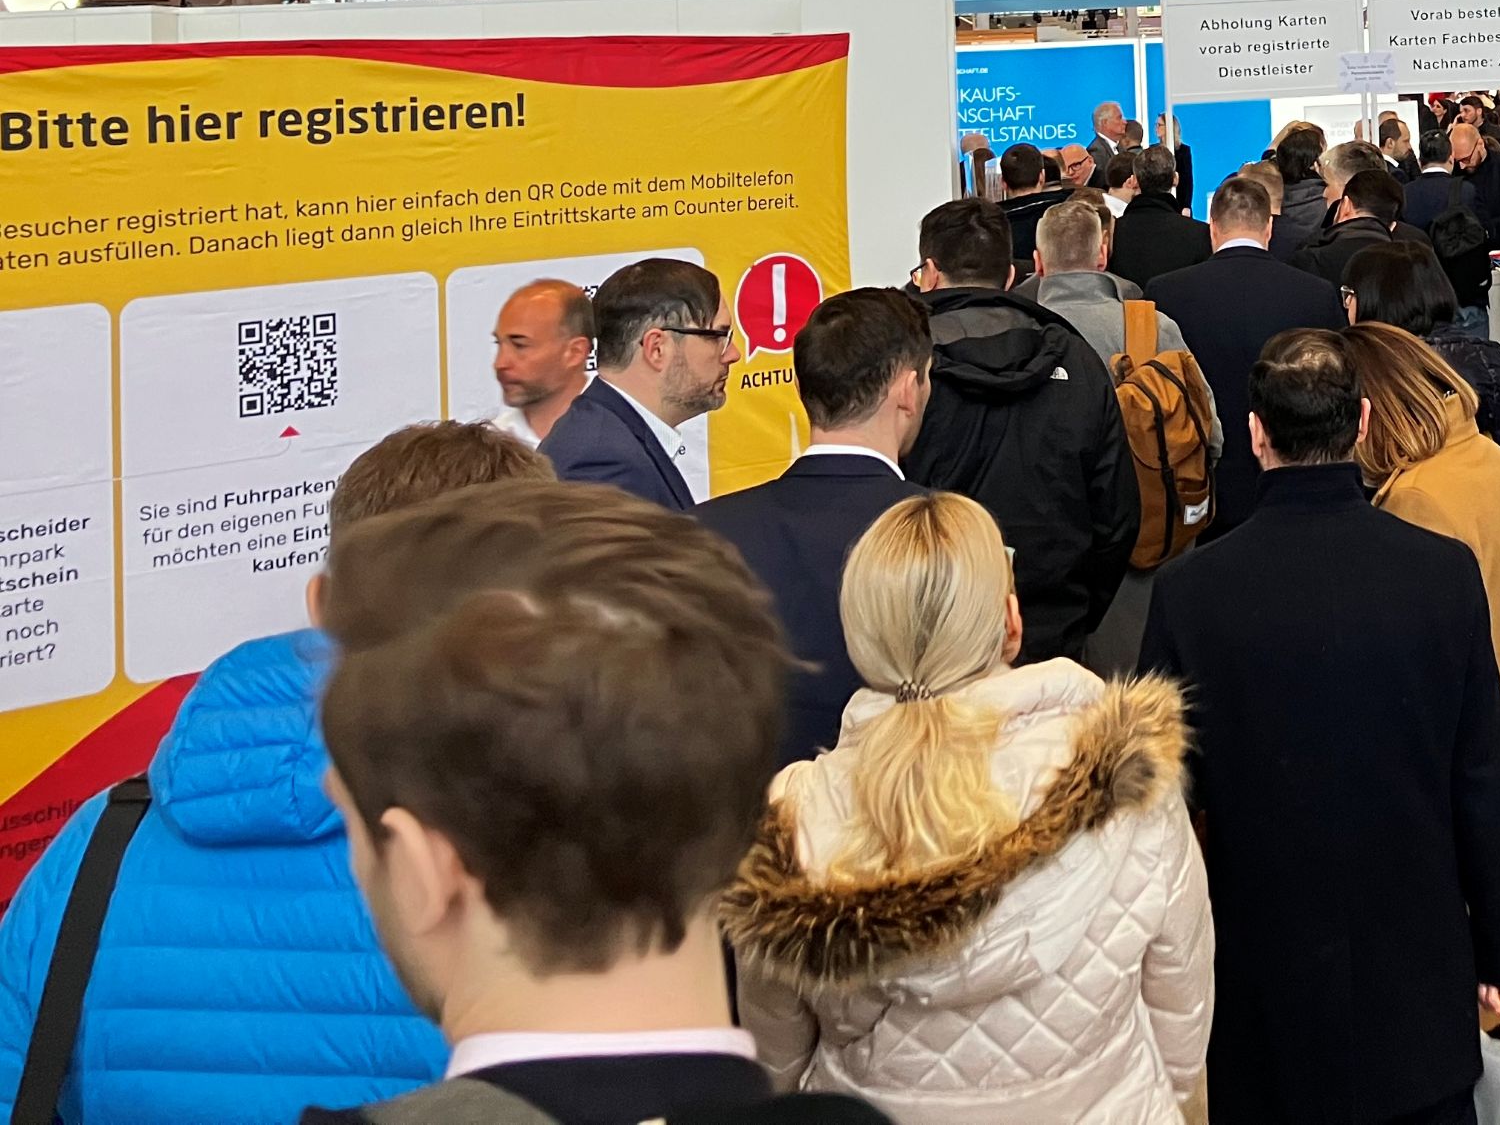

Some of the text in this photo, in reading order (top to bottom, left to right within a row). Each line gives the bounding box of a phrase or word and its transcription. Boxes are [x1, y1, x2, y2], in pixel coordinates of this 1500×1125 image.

[1200, 14, 1327, 31] Abholung Karten
[1410, 8, 1453, 21] Vorab
[1199, 38, 1330, 55] vorab registrierte
[1389, 34, 1437, 47] Karten
[1218, 63, 1314, 79] Dienstleister
[1413, 56, 1494, 71] Nachname:
[957, 86, 1022, 104] KAUFS-
[0, 92, 525, 152] Bitte hier registrieren!
[0, 169, 794, 240] esucher registriert hat, kann hier einfach den QR Code mit dem Mobiltelefon
[57, 241, 181, 266] ausfüllen.
[189, 230, 279, 255] Danach
[286, 225, 335, 249] liegt
[341, 224, 395, 242] dann
[401, 217, 463, 242] gleich
[469, 215, 508, 232] Ihre
[513, 203, 636, 228] Eintrittskarte
[641, 203, 669, 218] am
[674, 198, 743, 217] Counter
[747, 193, 800, 211] bereit.
[139, 477, 341, 522] Sie sind Fuhrparken
[143, 527, 173, 545] für
[177, 523, 214, 539] den
[220, 508, 297, 533] eigenen
[153, 541, 241, 568] möchten
[247, 533, 287, 551] eine
[252, 546, 330, 573] kaufen?
[0, 597, 44, 618] arte
[6, 619, 59, 642] noch
[0, 643, 56, 669] riert?
